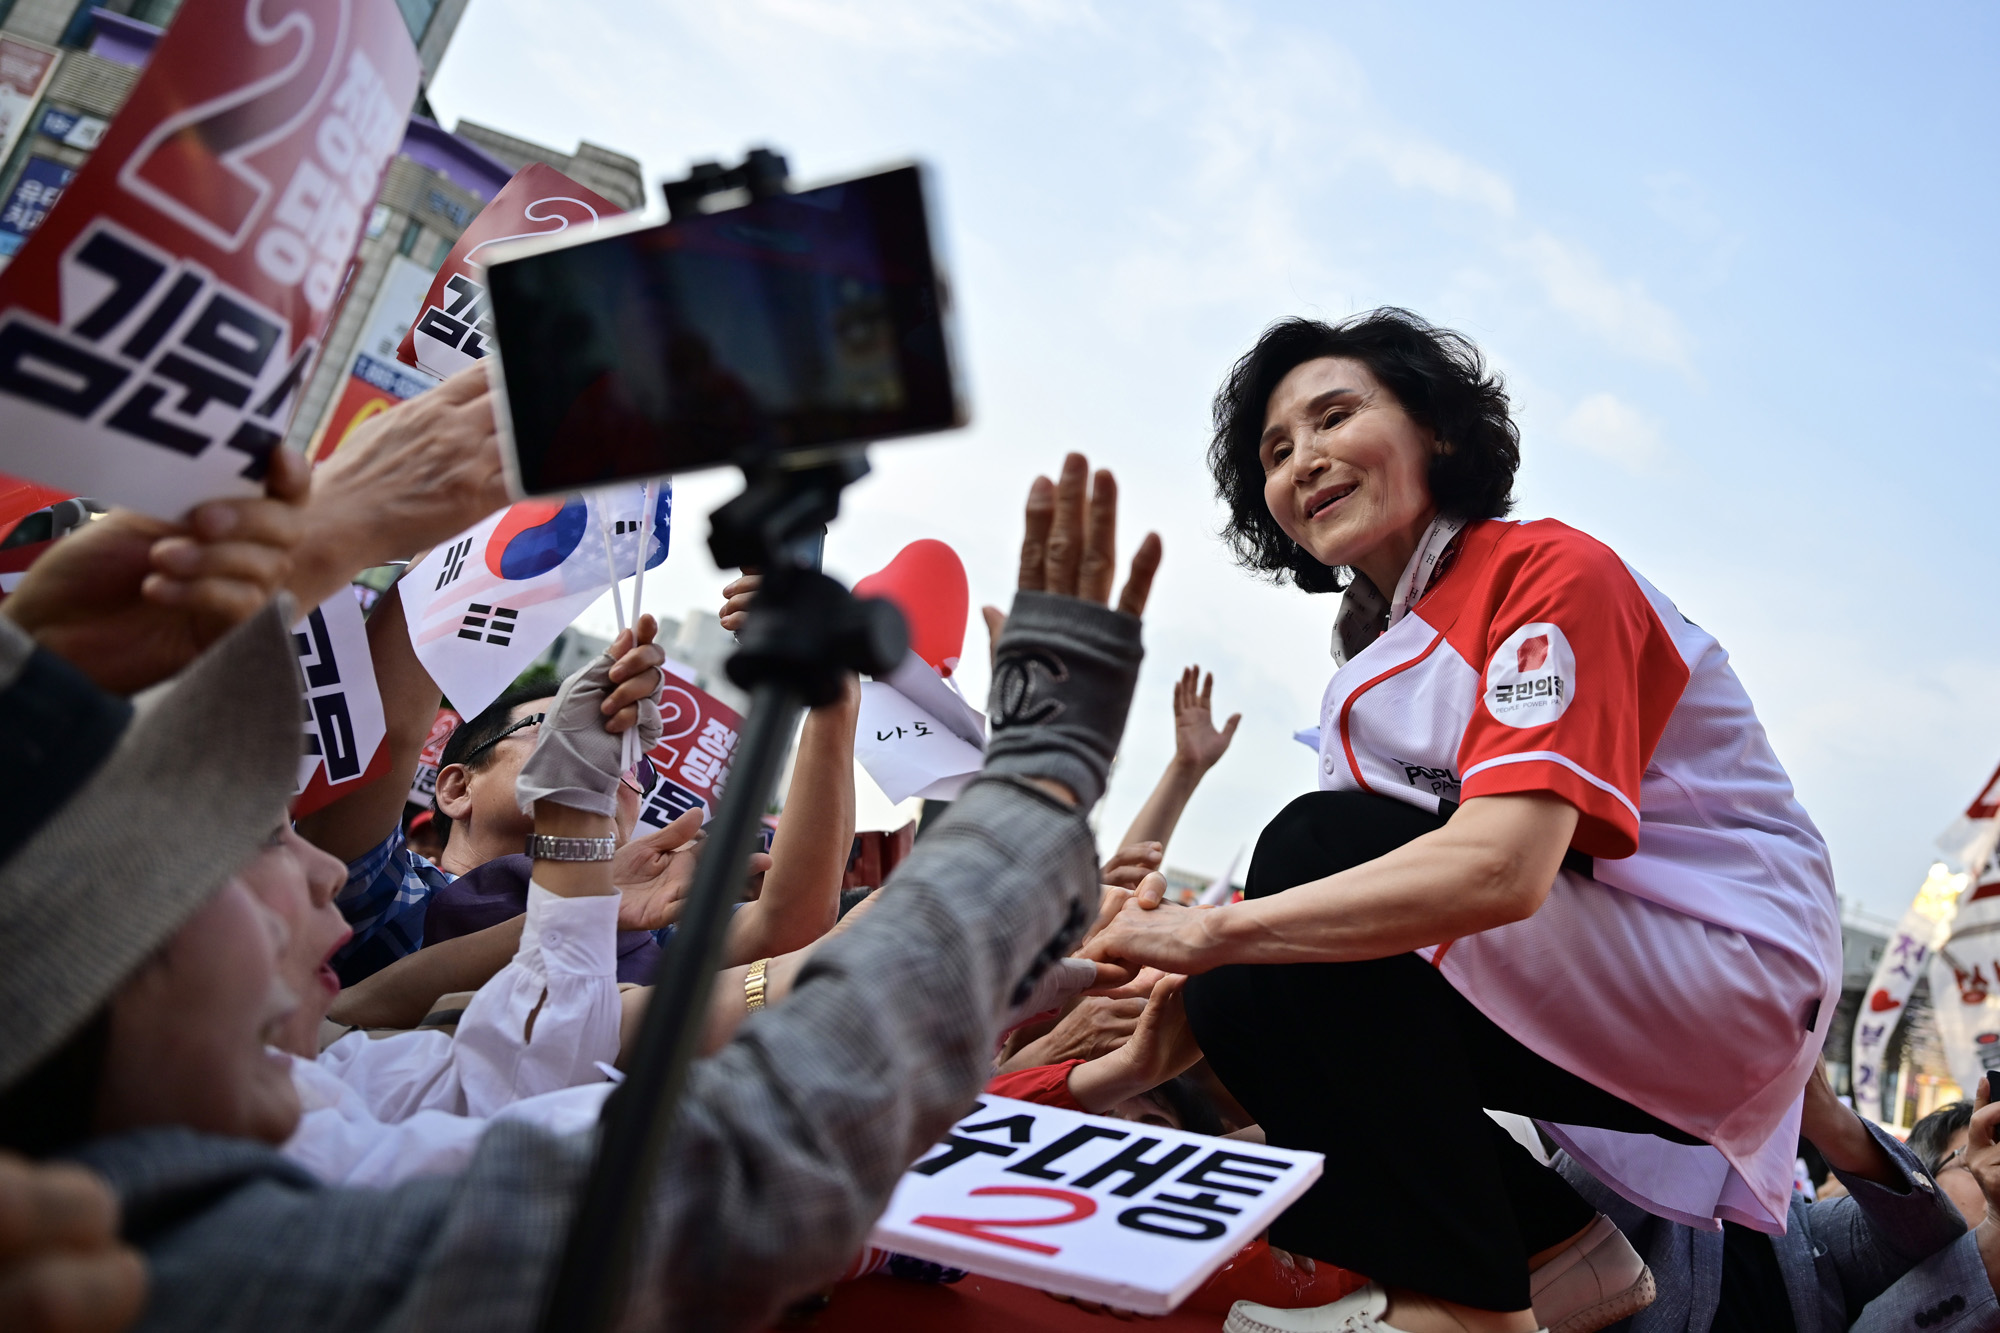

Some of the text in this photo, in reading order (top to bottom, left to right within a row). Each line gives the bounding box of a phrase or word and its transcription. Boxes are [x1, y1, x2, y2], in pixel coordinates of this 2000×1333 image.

[118, 0, 352, 252] 2
[645, 685, 702, 770] 2
[1523, 700, 1548, 708] POWER
[697, 717, 741, 767] 정
[877, 722, 933, 741] 나도
[1431, 780, 1461, 795] PA
[911, 1186, 1098, 1257] 2
